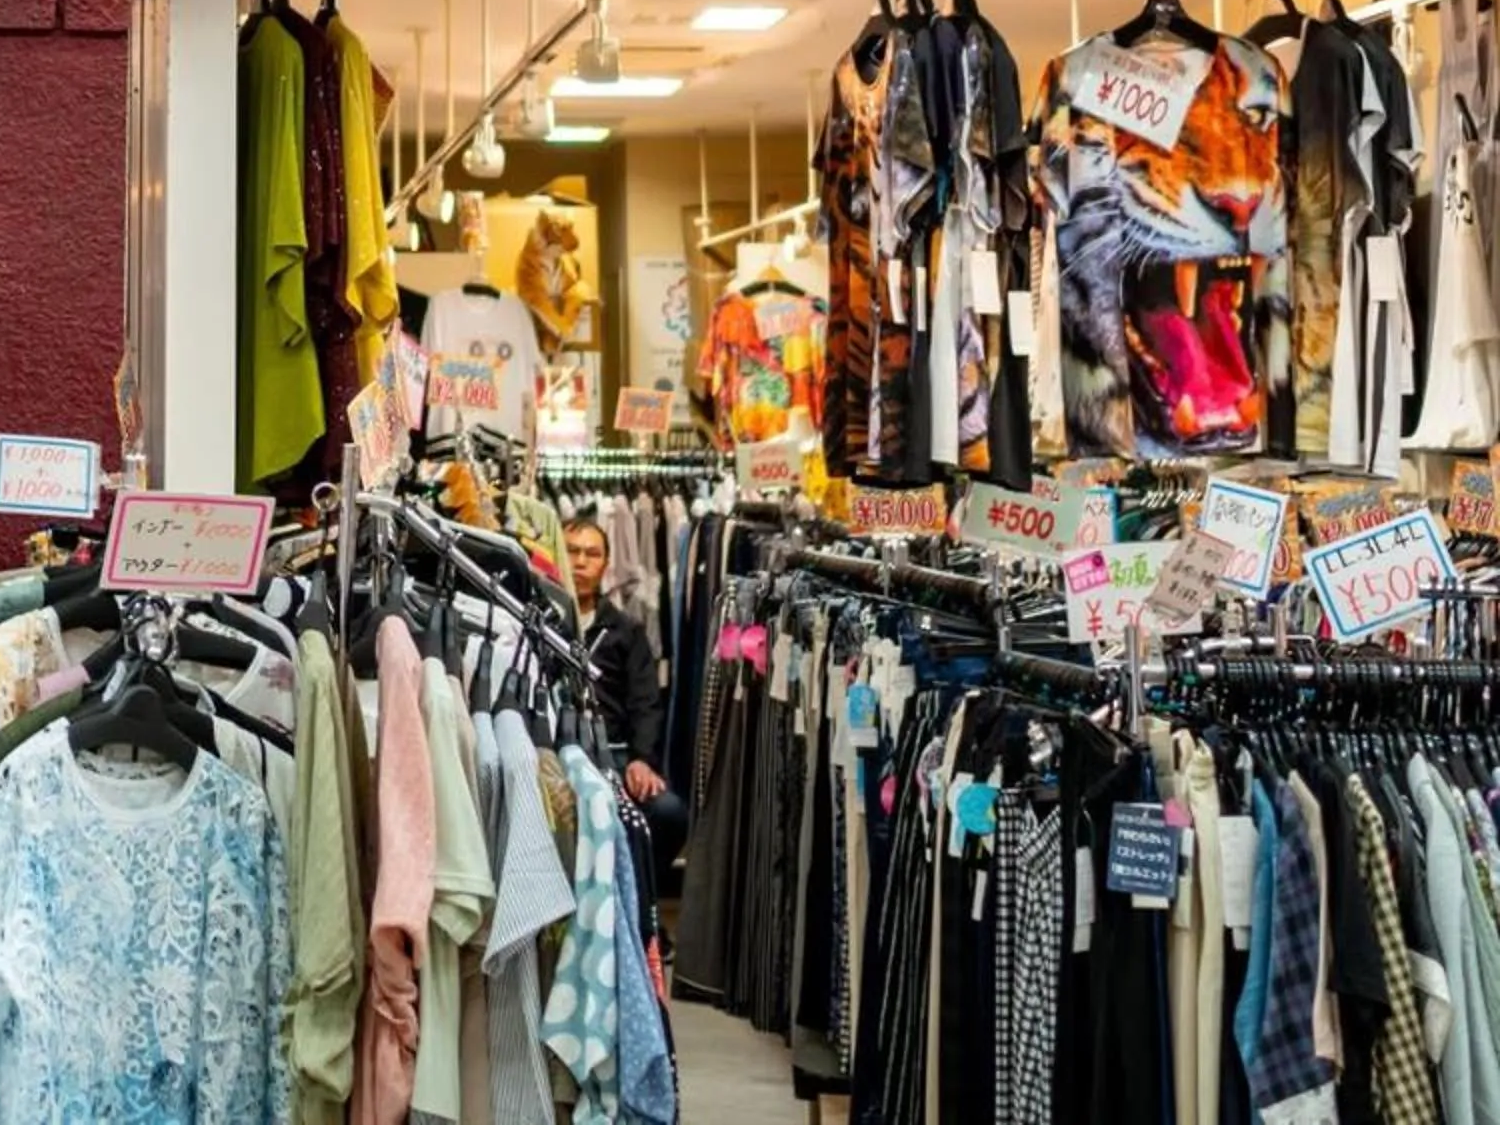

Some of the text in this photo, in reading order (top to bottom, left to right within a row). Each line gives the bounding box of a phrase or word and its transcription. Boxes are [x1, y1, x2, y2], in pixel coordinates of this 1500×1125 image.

[1096, 71, 1169, 126] ¥1000
[855, 496, 937, 526] ¥500
[987, 500, 1055, 540] ¥500
